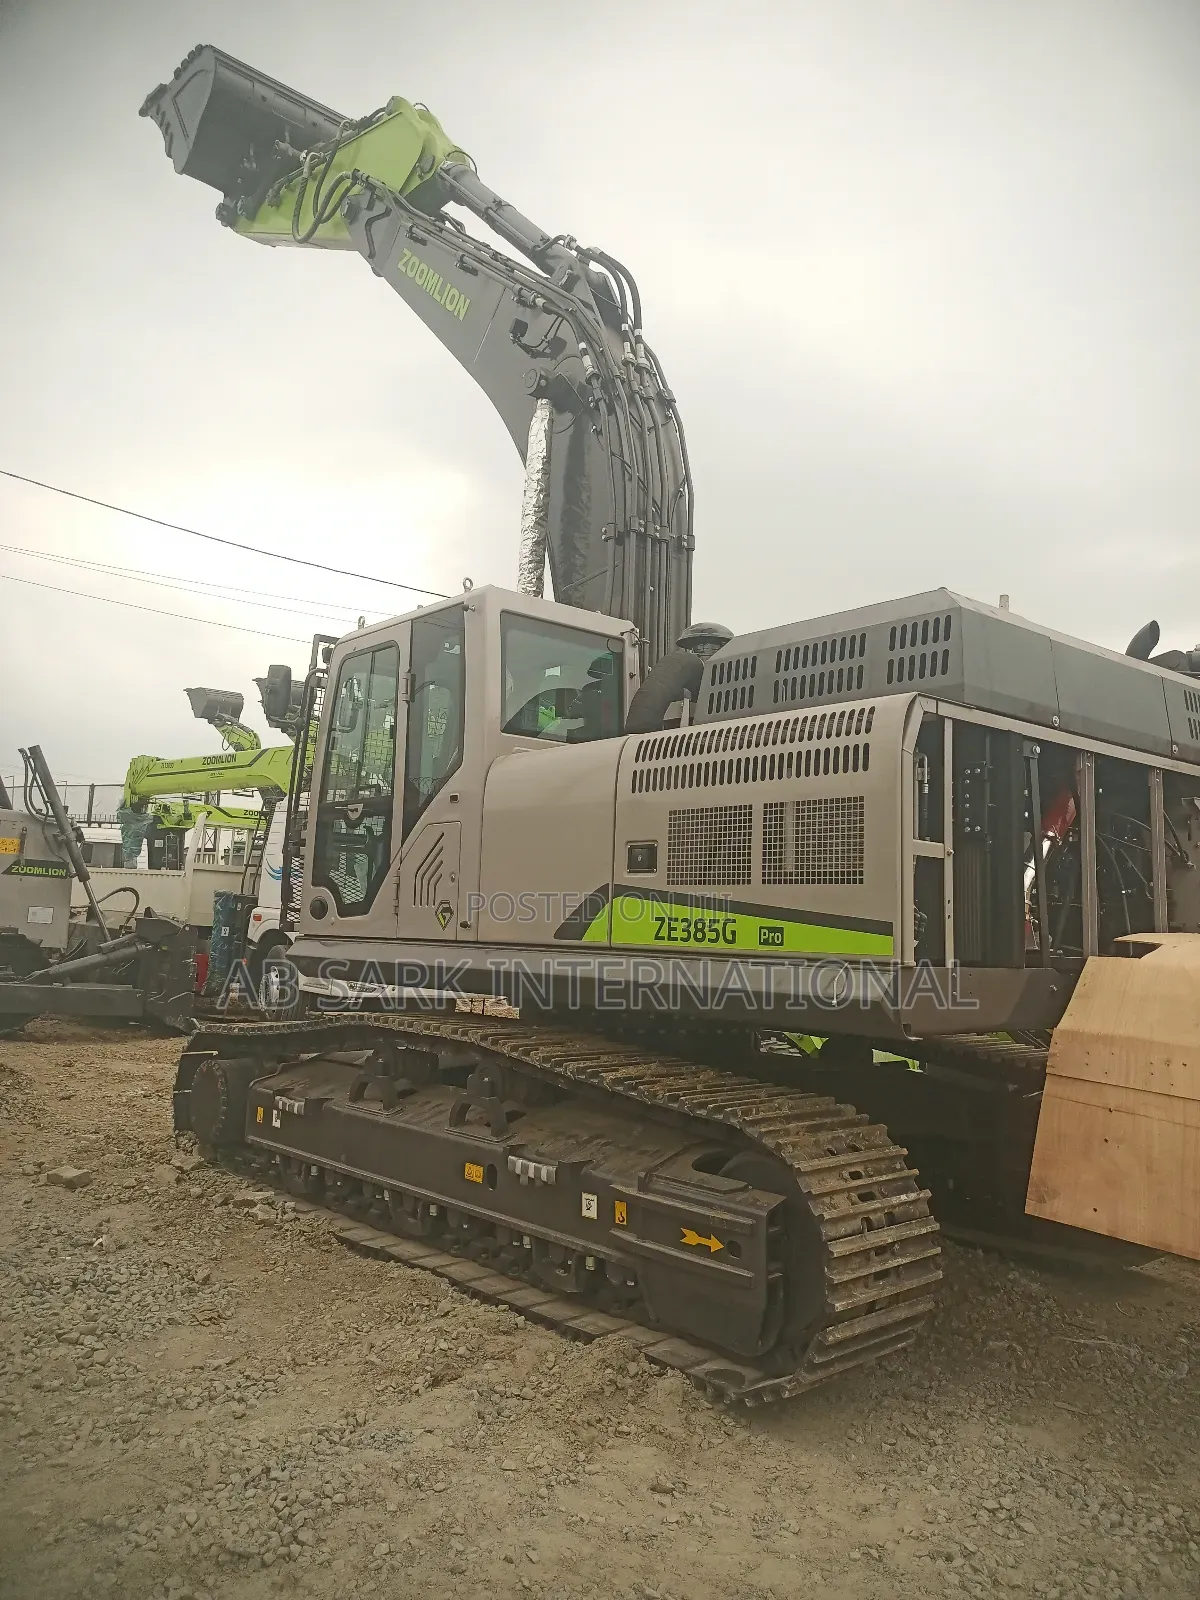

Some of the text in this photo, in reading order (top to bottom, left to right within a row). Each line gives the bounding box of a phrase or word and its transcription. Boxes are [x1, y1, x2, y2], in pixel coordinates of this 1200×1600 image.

[397, 247, 471, 321] ZOOMLION
[202, 754, 237, 766] ZOOMLION
[11, 865, 67, 877] ZOOMLION
[654, 917, 783, 945] ZE385G Pro
